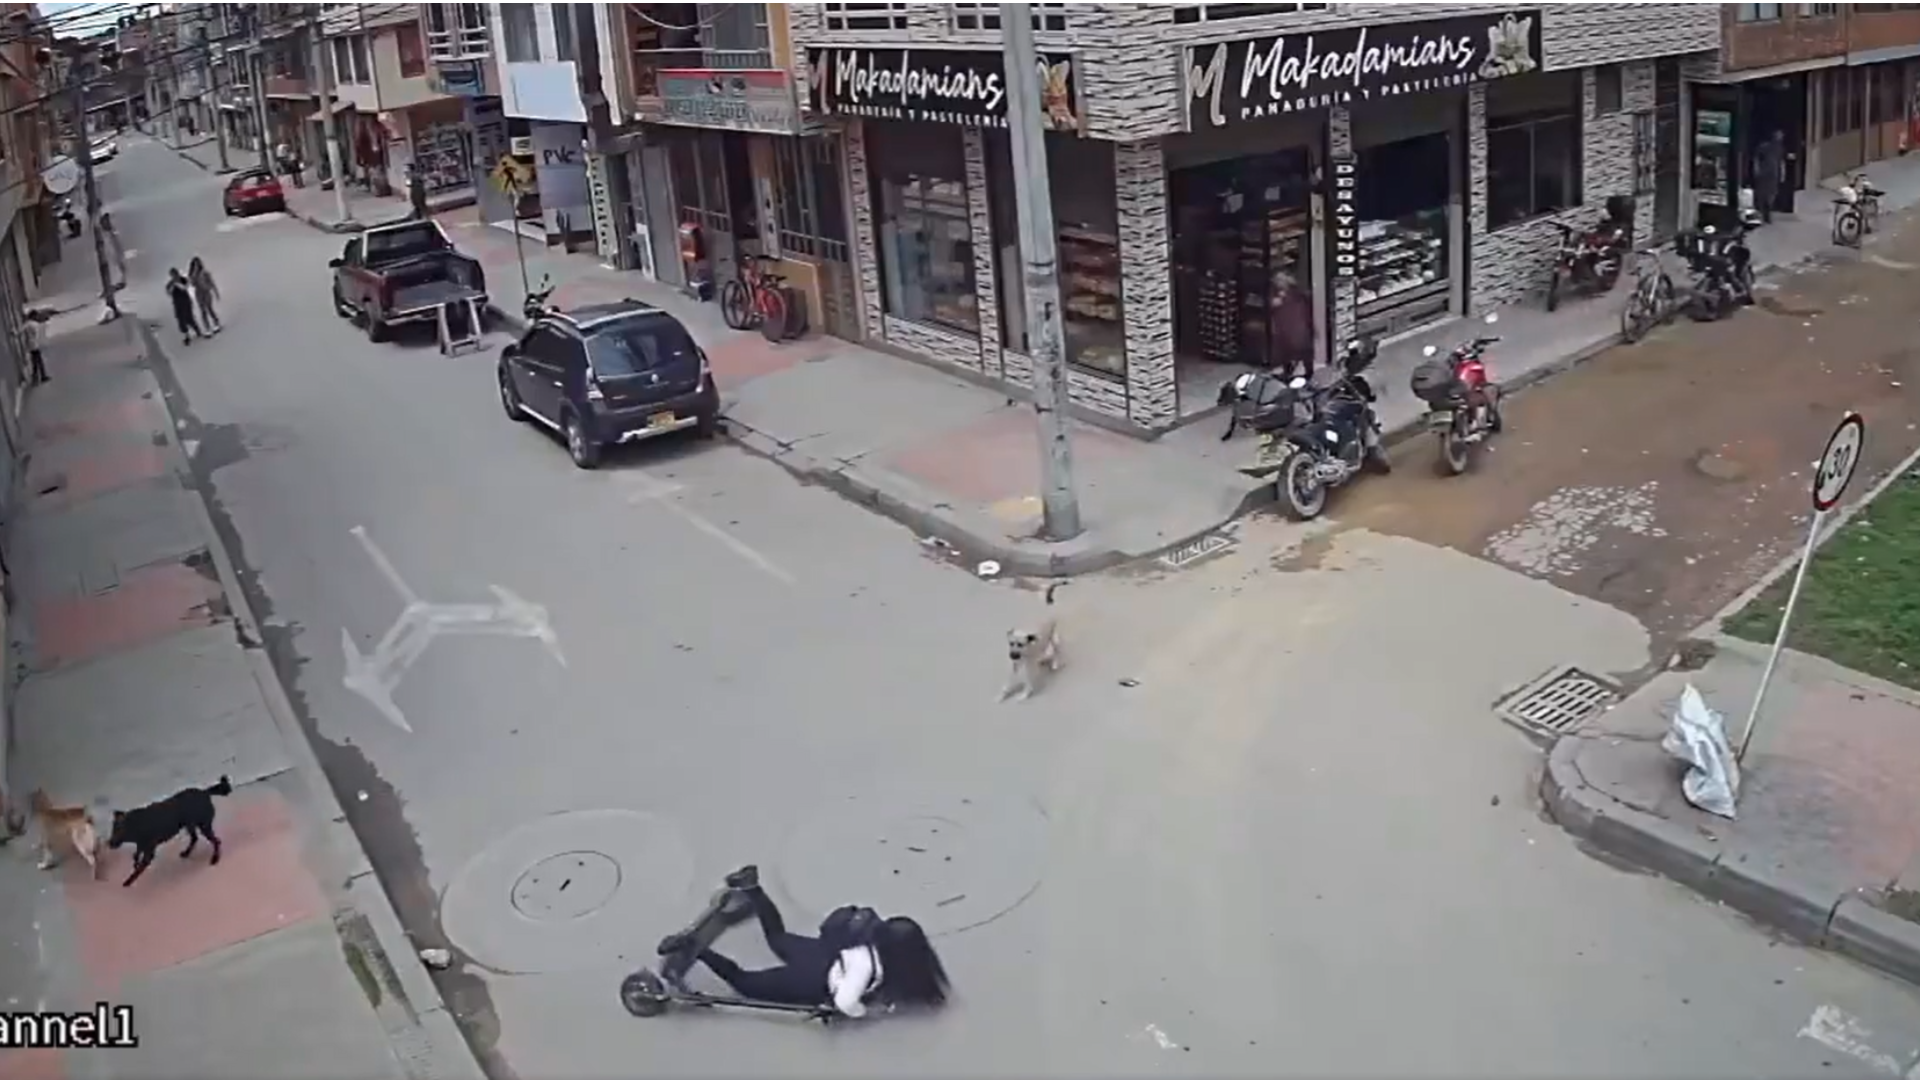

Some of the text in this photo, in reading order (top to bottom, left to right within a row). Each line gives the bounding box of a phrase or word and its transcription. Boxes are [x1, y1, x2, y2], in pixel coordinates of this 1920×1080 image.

[836, 50, 1004, 110] Makadamians
[1184, 27, 1476, 132] M Makadamians
[1336, 165, 1355, 276] DESAYUNOS
[1828, 445, 1851, 480] 30
